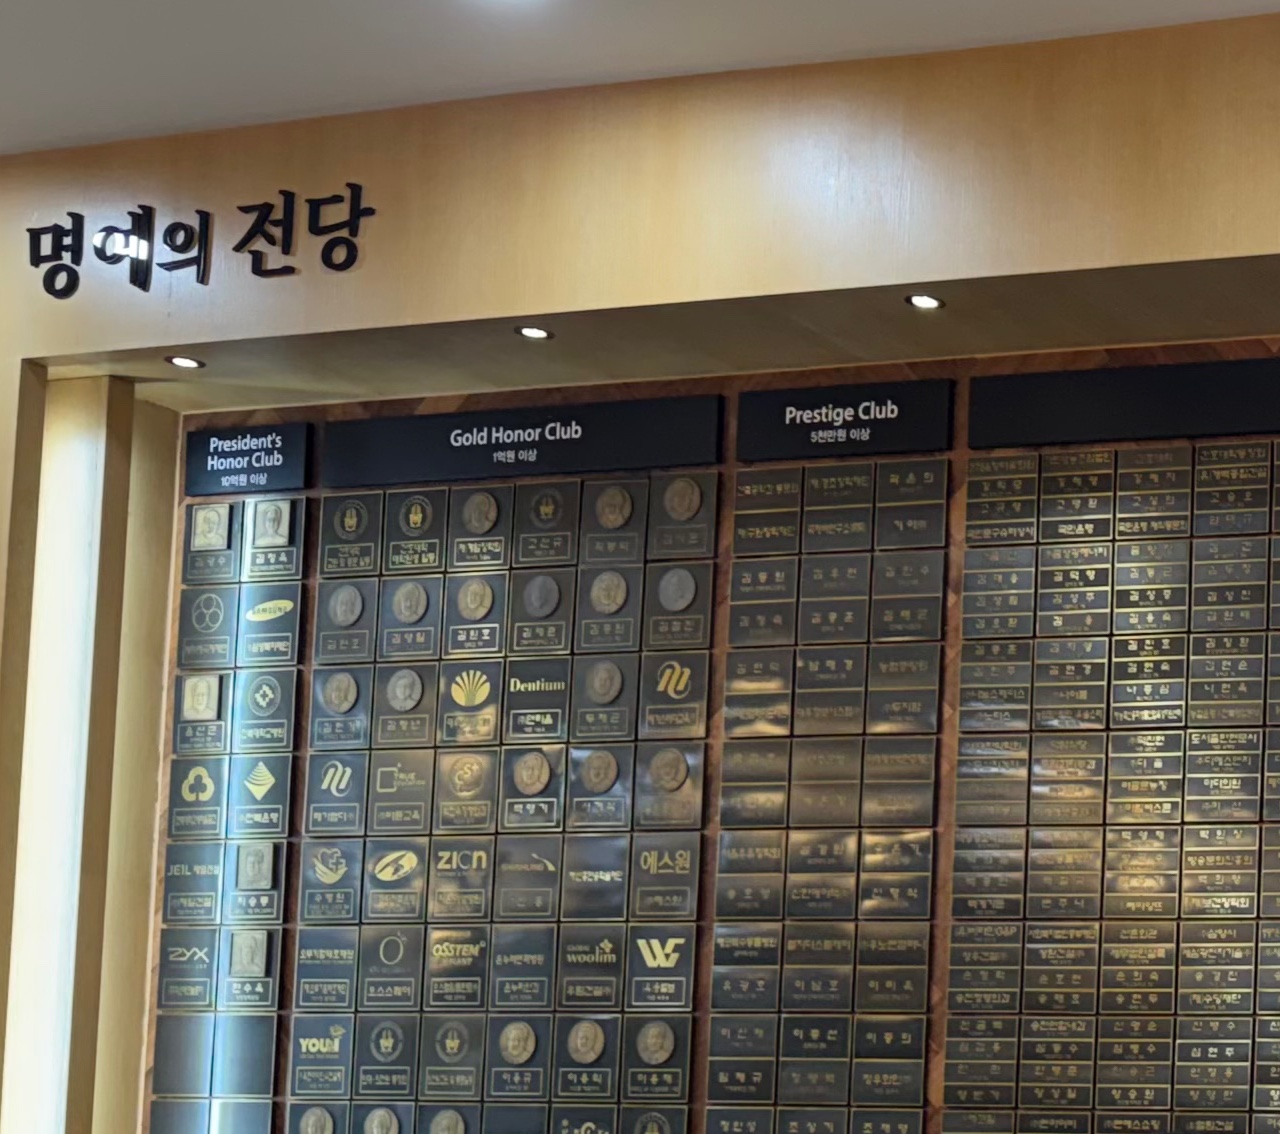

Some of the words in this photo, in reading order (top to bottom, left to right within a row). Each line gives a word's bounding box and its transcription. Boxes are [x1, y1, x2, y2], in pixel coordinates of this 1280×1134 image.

[28, 205, 211, 299] 명예의
[233, 183, 375, 277] 전당
[785, 404, 855, 425] Prestige
[858, 400, 898, 420] Club
[210, 433, 282, 451] President's
[450, 428, 487, 447] Gold
[491, 425, 541, 444] Honor
[545, 421, 581, 440] Club
[810, 429, 847, 443] 5천만원
[850, 427, 870, 440] 이상
[207, 454, 248, 471] Honor
[252, 451, 283, 467] Club
[493, 450, 515, 463] 1억원
[518, 449, 536, 461] 이상
[221, 474, 247, 486] 10억원
[250, 473, 267, 484] 이상
[510, 676, 565, 693] Dentium
[167, 864, 191, 875] JEIL
[641, 850, 690, 874] 에스원
